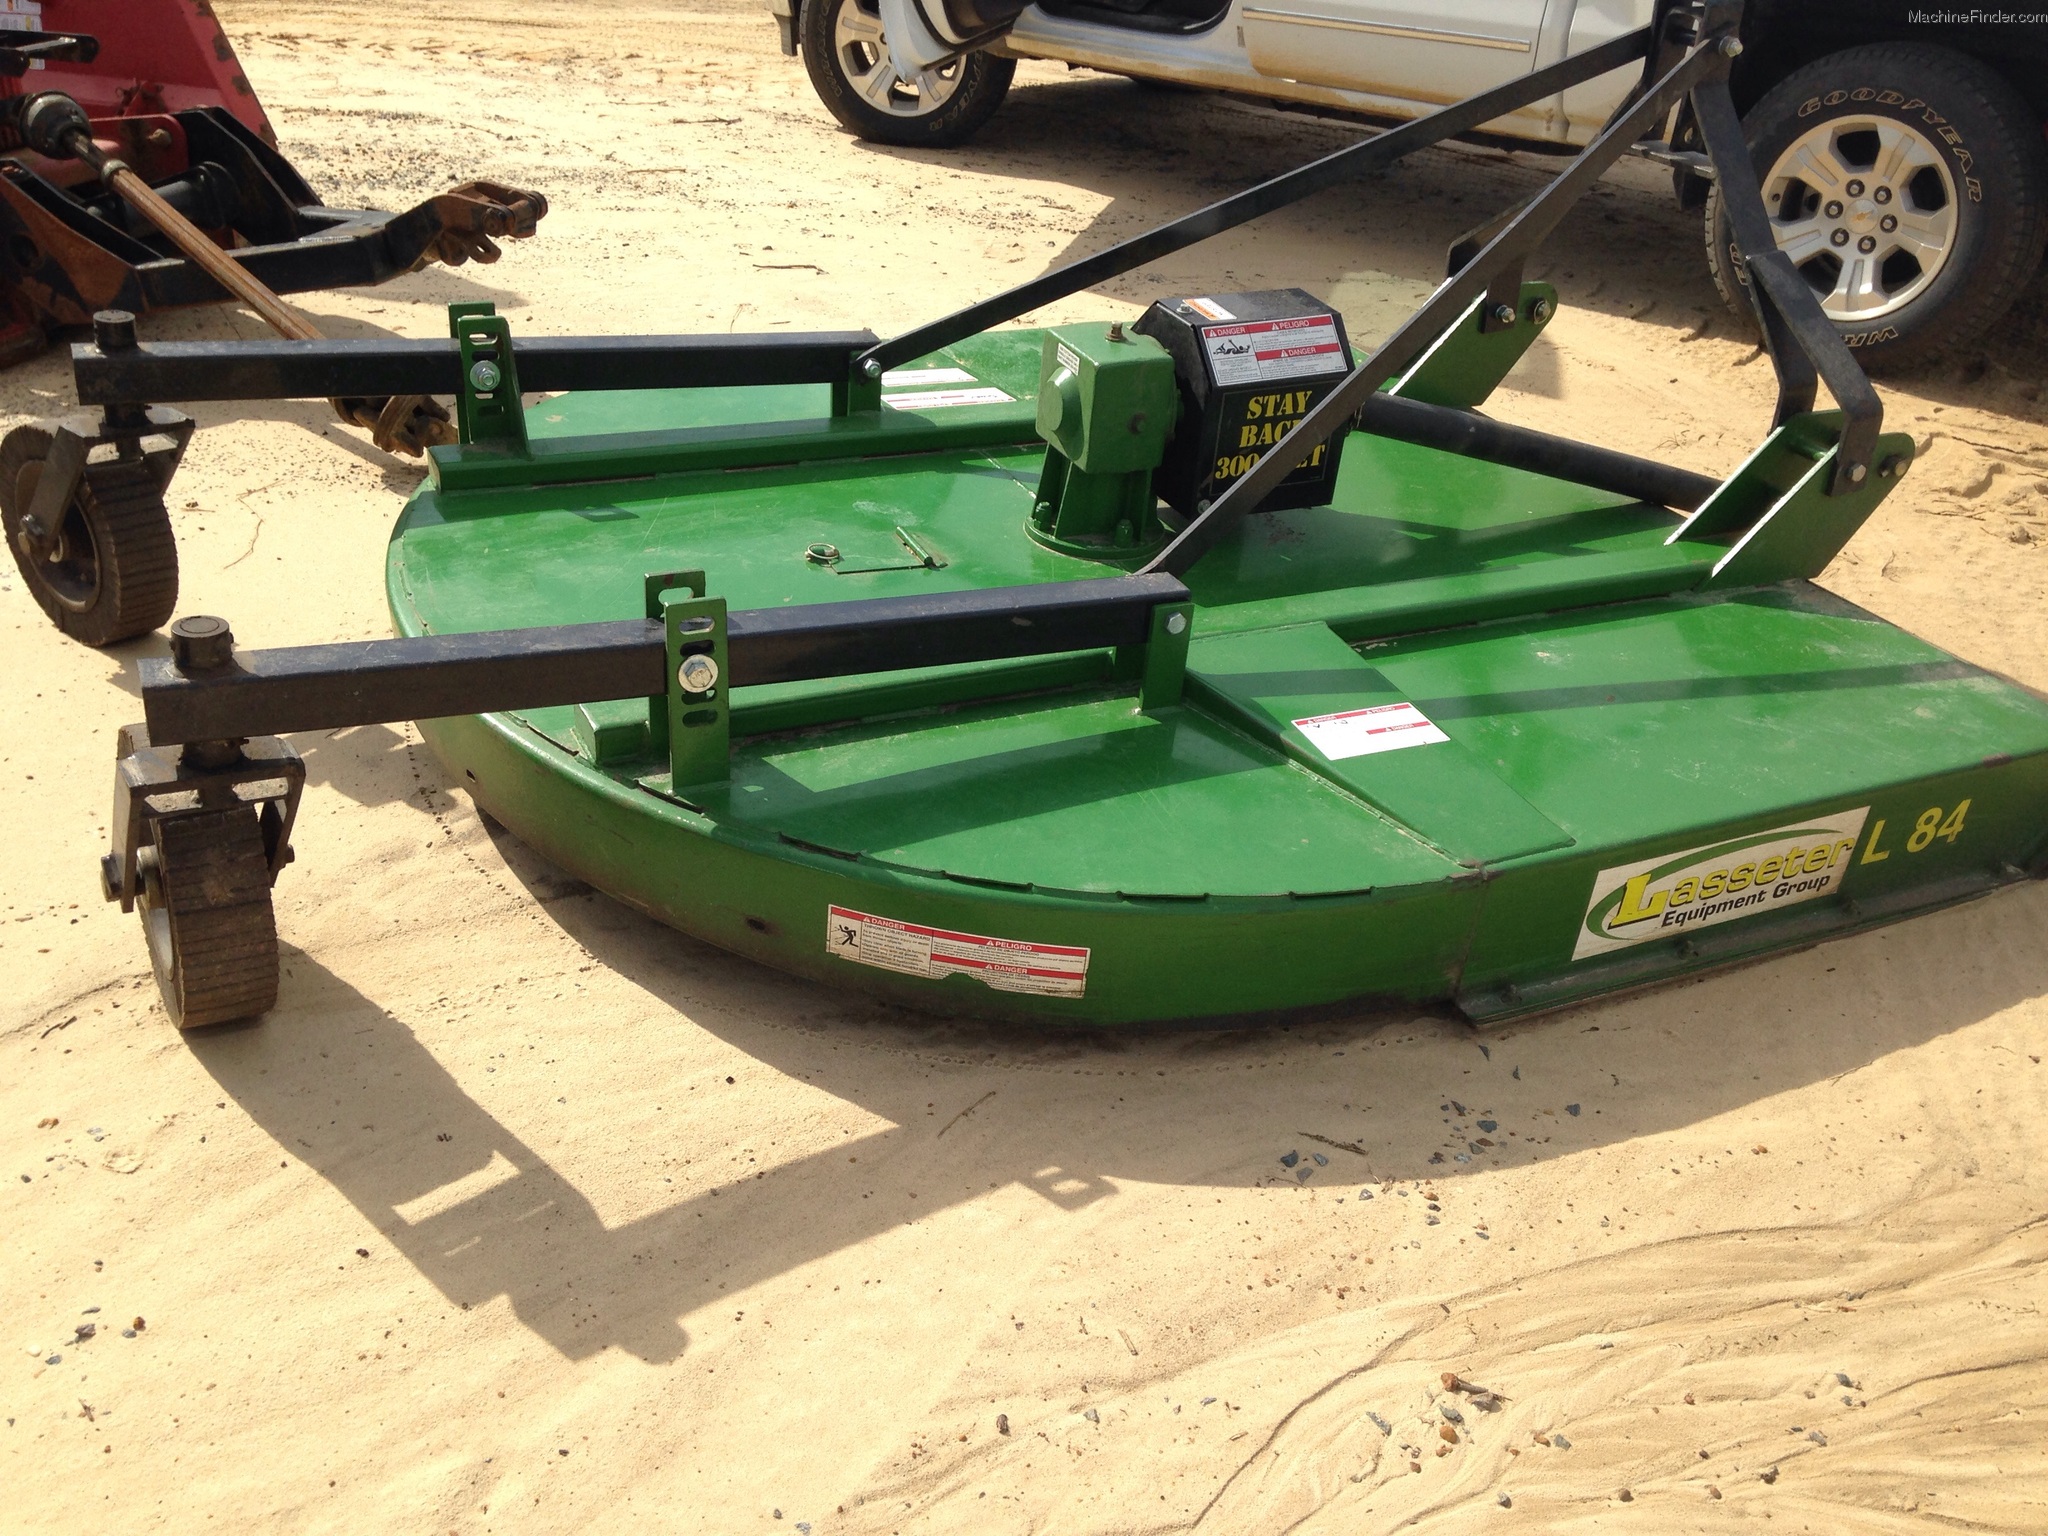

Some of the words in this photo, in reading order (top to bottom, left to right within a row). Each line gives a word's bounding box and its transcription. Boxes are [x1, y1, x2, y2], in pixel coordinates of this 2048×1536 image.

[1797, 87, 1983, 203] GOODYEAR
[1217, 326, 1246, 336] DANGER
[1279, 320, 1310, 330] PELIGRO
[1288, 346, 1317, 357] DANGER
[1247, 391, 1312, 419] STAY
[1215, 452, 1261, 479] 300
[1860, 819, 1890, 865] L
[1906, 799, 1972, 853] 84
[1607, 837, 1856, 930] Lasseter
[1661, 889, 1767, 929] Equipment
[1772, 874, 1831, 899] Group
[871, 918, 906, 930] DANGER
[995, 941, 1032, 951] PELIGRO
[994, 965, 1028, 975] DANGER
